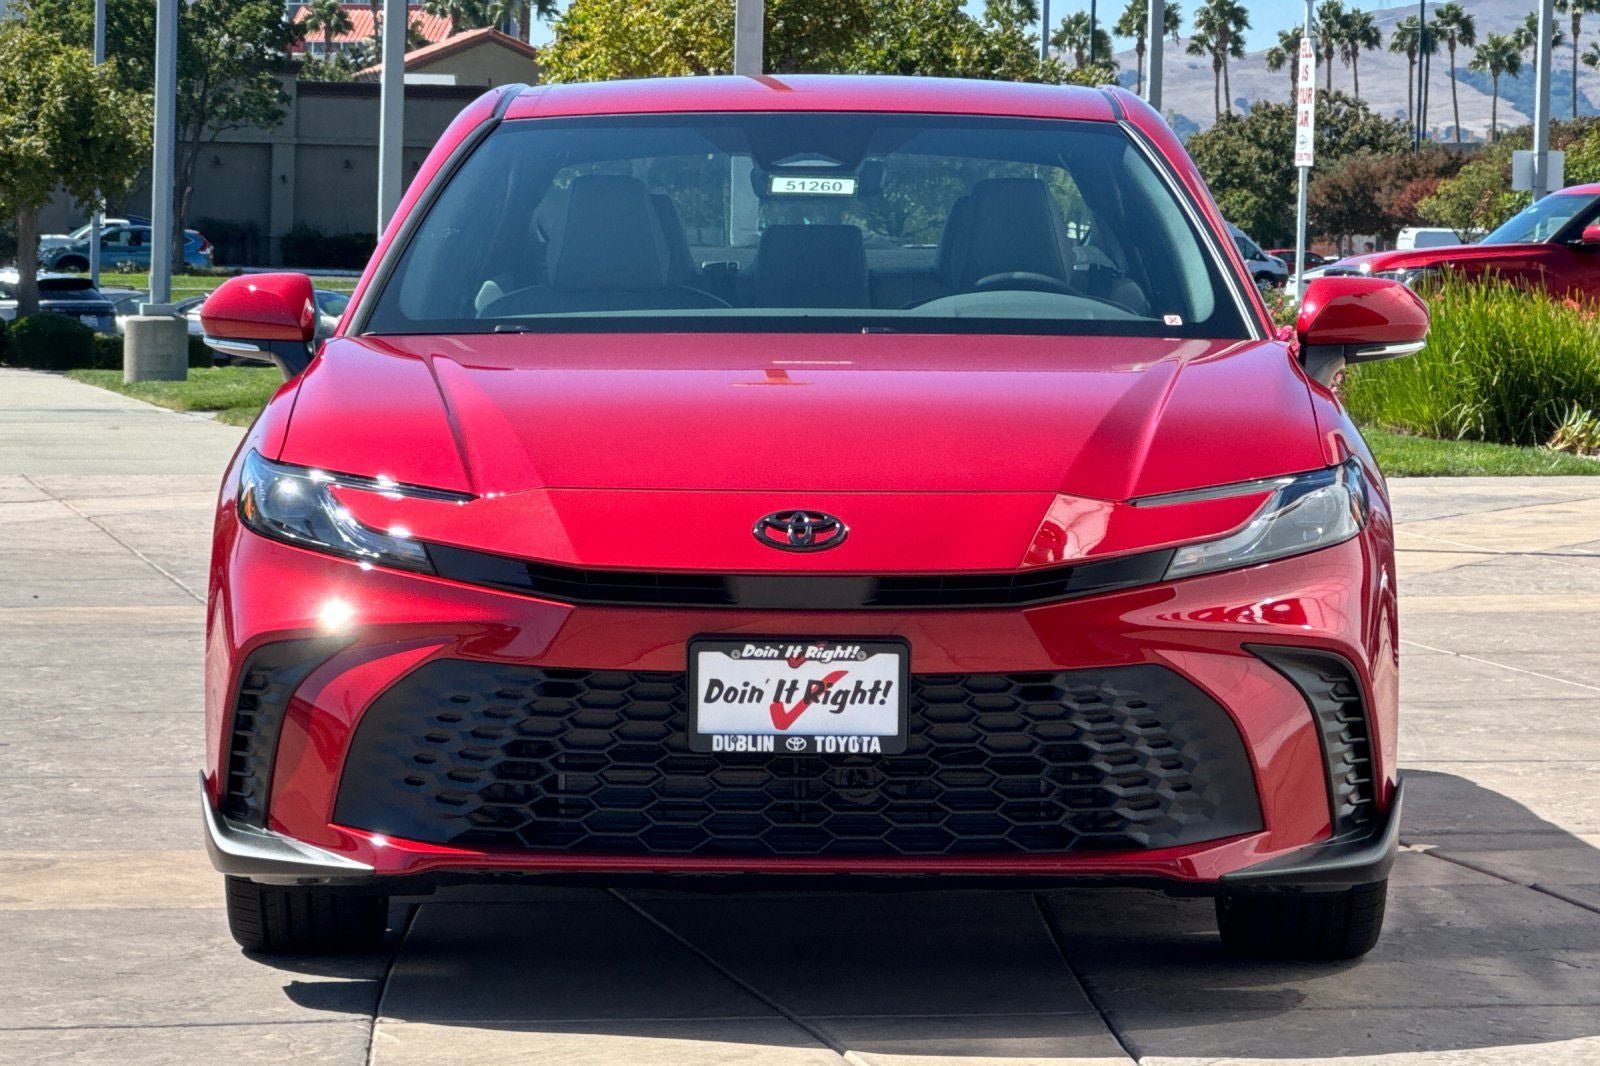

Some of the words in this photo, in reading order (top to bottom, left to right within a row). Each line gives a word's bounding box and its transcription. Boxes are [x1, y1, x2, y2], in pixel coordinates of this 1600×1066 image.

[1298, 110, 1309, 127] AR
[785, 180, 843, 191] 51260
[741, 644, 782, 659] Doin'
[785, 644, 802, 659] It
[805, 645, 860, 663] Right!
[704, 678, 770, 704] Doin'
[773, 679, 799, 704] It
[803, 679, 893, 714] Right!
[712, 735, 774, 752] DUBLIN
[814, 736, 881, 753] TOYOTA
